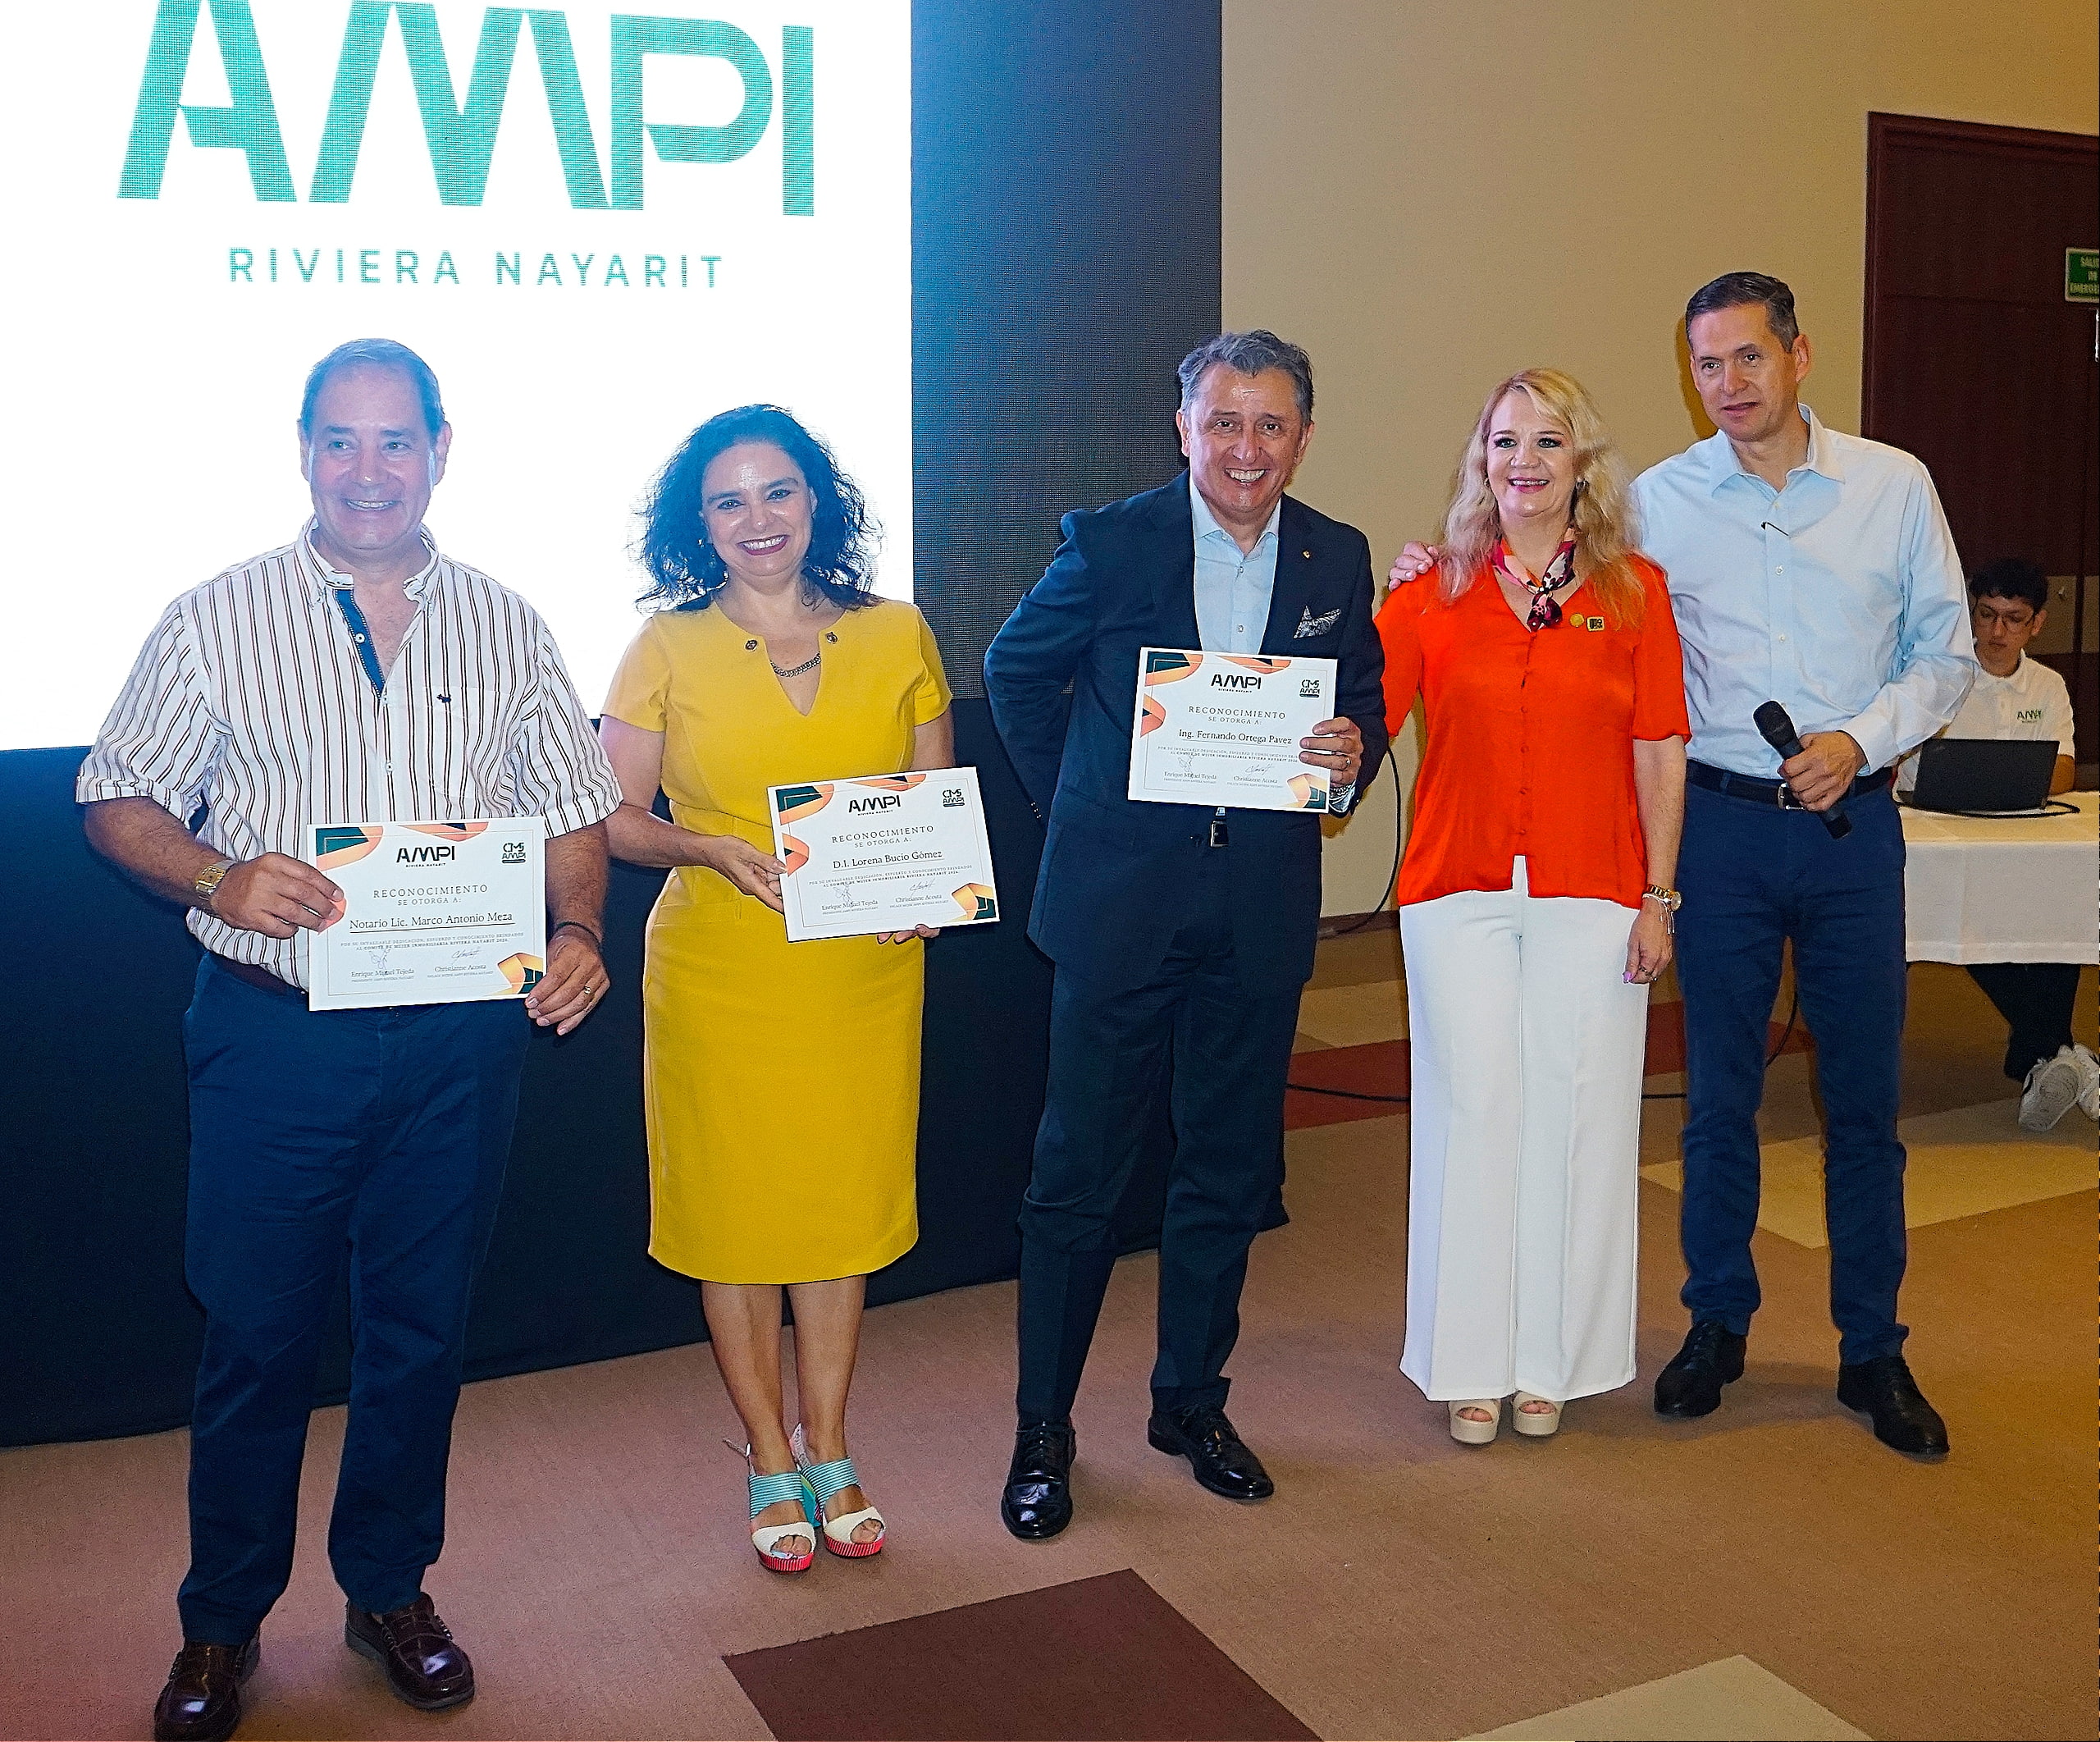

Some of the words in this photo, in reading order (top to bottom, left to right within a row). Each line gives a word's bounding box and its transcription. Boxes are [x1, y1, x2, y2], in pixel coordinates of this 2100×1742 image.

[116, 0, 814, 216] AMPI
[230, 246, 459, 284] RIVIERA
[495, 250, 722, 288] NAYARIT
[1211, 674, 1261, 689] AMPI
[1189, 706, 1285, 719] RECONOCIMIENTO
[1179, 729, 1194, 738] Ing.
[1197, 730, 1236, 740] Fernando
[1239, 733, 1266, 743] Ortega
[1268, 735, 1292, 744] Pavez
[848, 795, 901, 812] AMPI
[832, 825, 934, 844] RECONOCIMIENTO
[867, 839, 900, 847] OTORGA
[396, 846, 455, 862] AMPI
[833, 859, 850, 869] D.I.
[852, 856, 883, 866] Lorena
[884, 853, 910, 863] Bucio
[912, 849, 943, 860] Gómez
[373, 884, 488, 898] RECONOCIMIENTO
[349, 918, 388, 929] Notario
[390, 917, 408, 927] Lic.
[412, 915, 443, 926] Marco
[445, 914, 484, 924] Antonio
[487, 912, 513, 921] Meza
